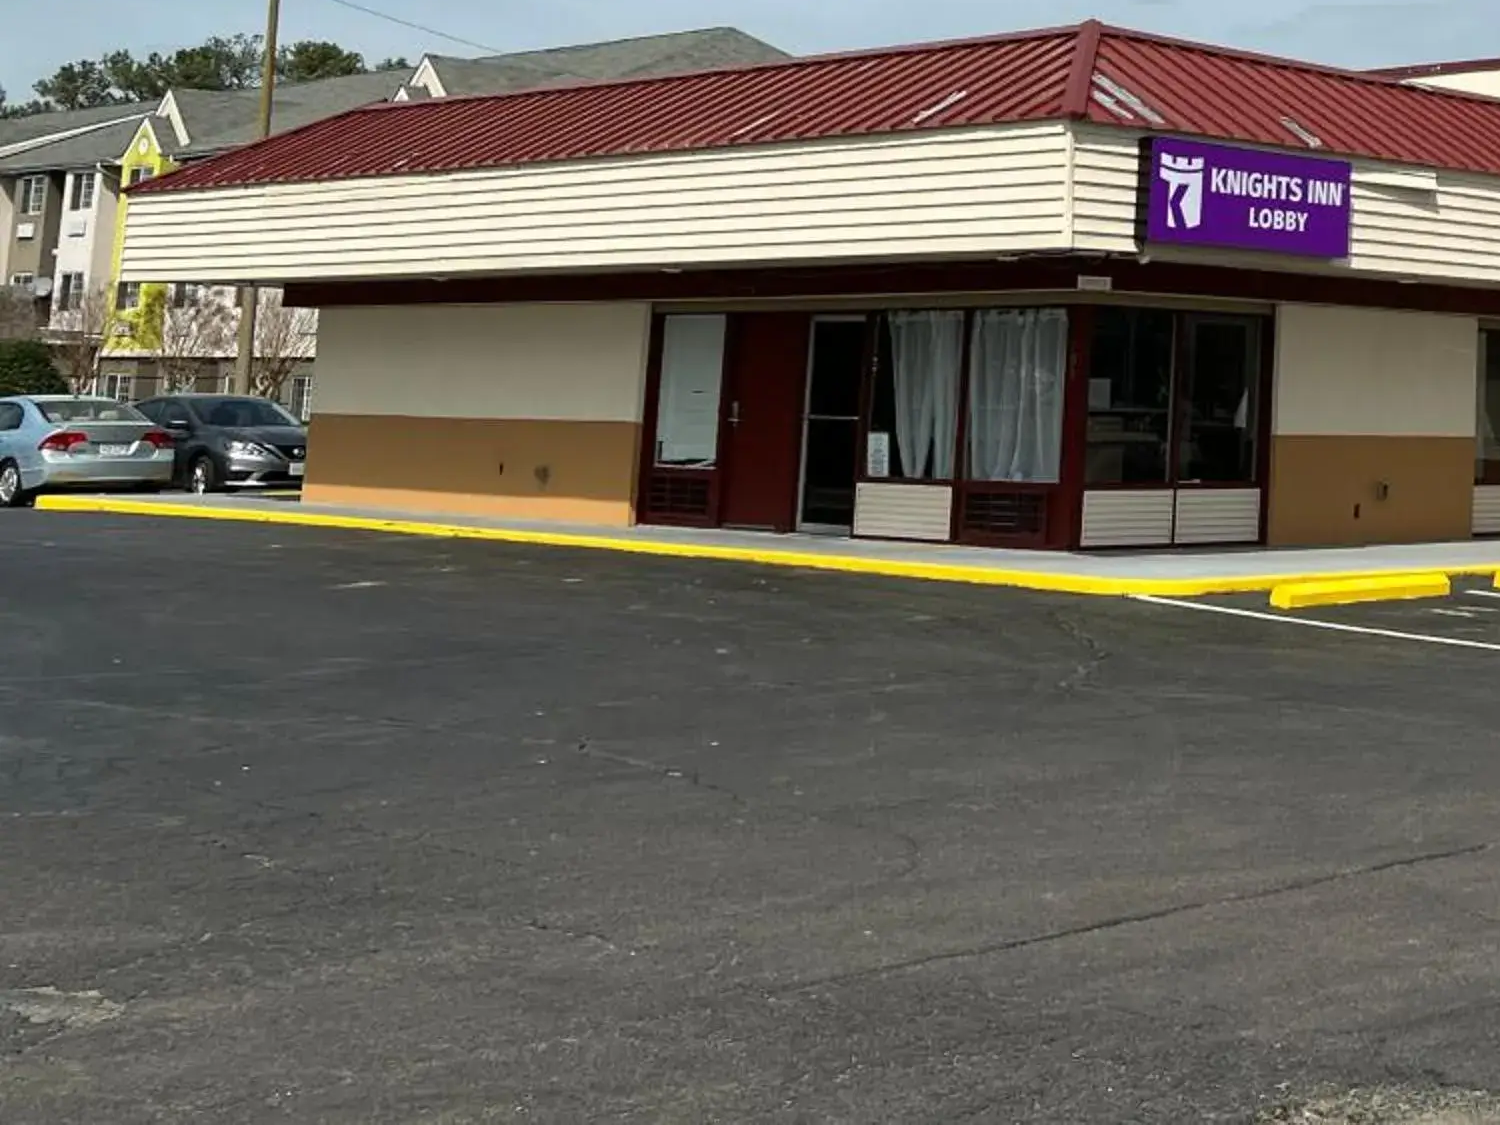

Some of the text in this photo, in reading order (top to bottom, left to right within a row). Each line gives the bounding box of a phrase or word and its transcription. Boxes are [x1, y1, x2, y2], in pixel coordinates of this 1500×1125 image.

[1210, 167, 1342, 207] KNIGHTS INN
[1248, 207, 1308, 232] LOBBY
